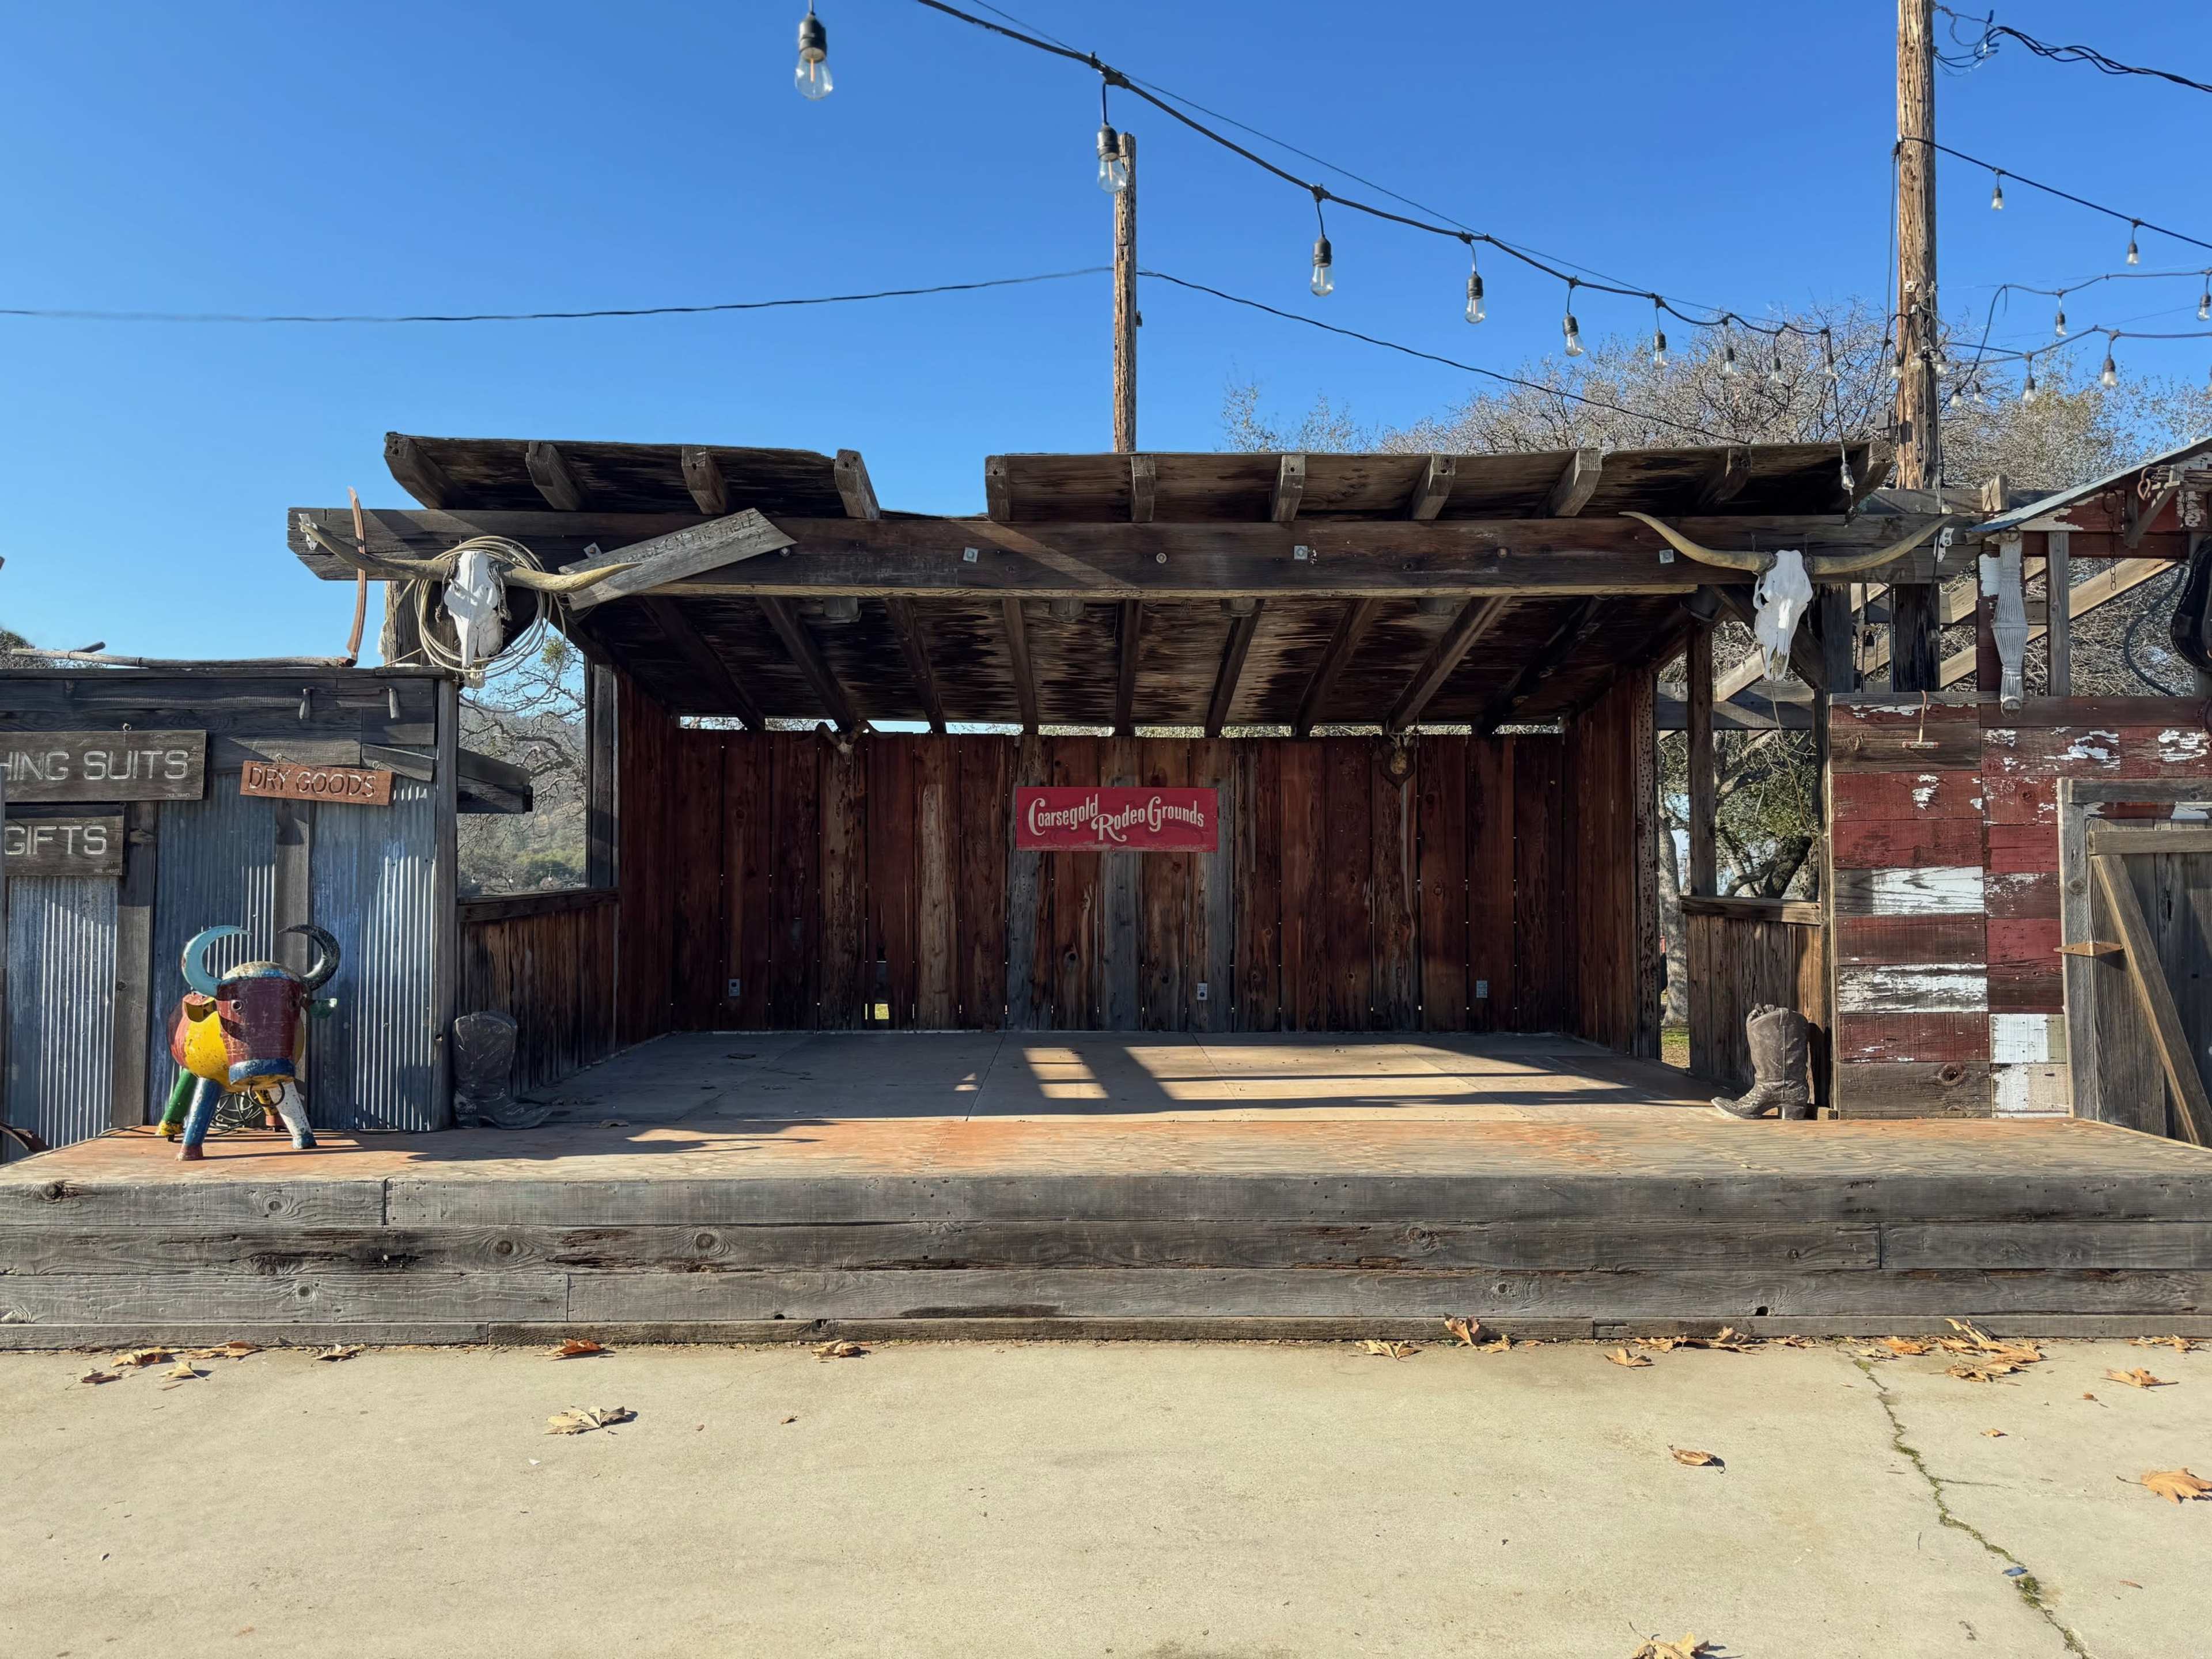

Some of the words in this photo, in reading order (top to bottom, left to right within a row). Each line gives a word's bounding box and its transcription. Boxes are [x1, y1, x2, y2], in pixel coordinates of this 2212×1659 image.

[84, 751, 189, 780] SUITS
[249, 766, 291, 791] DRY
[296, 771, 377, 798] GOODS
[1028, 793, 1099, 836] Coarsegold
[1090, 804, 1146, 842] Rodeo
[1147, 796, 1205, 832] Grounds
[5, 825, 107, 855] GIFTS
